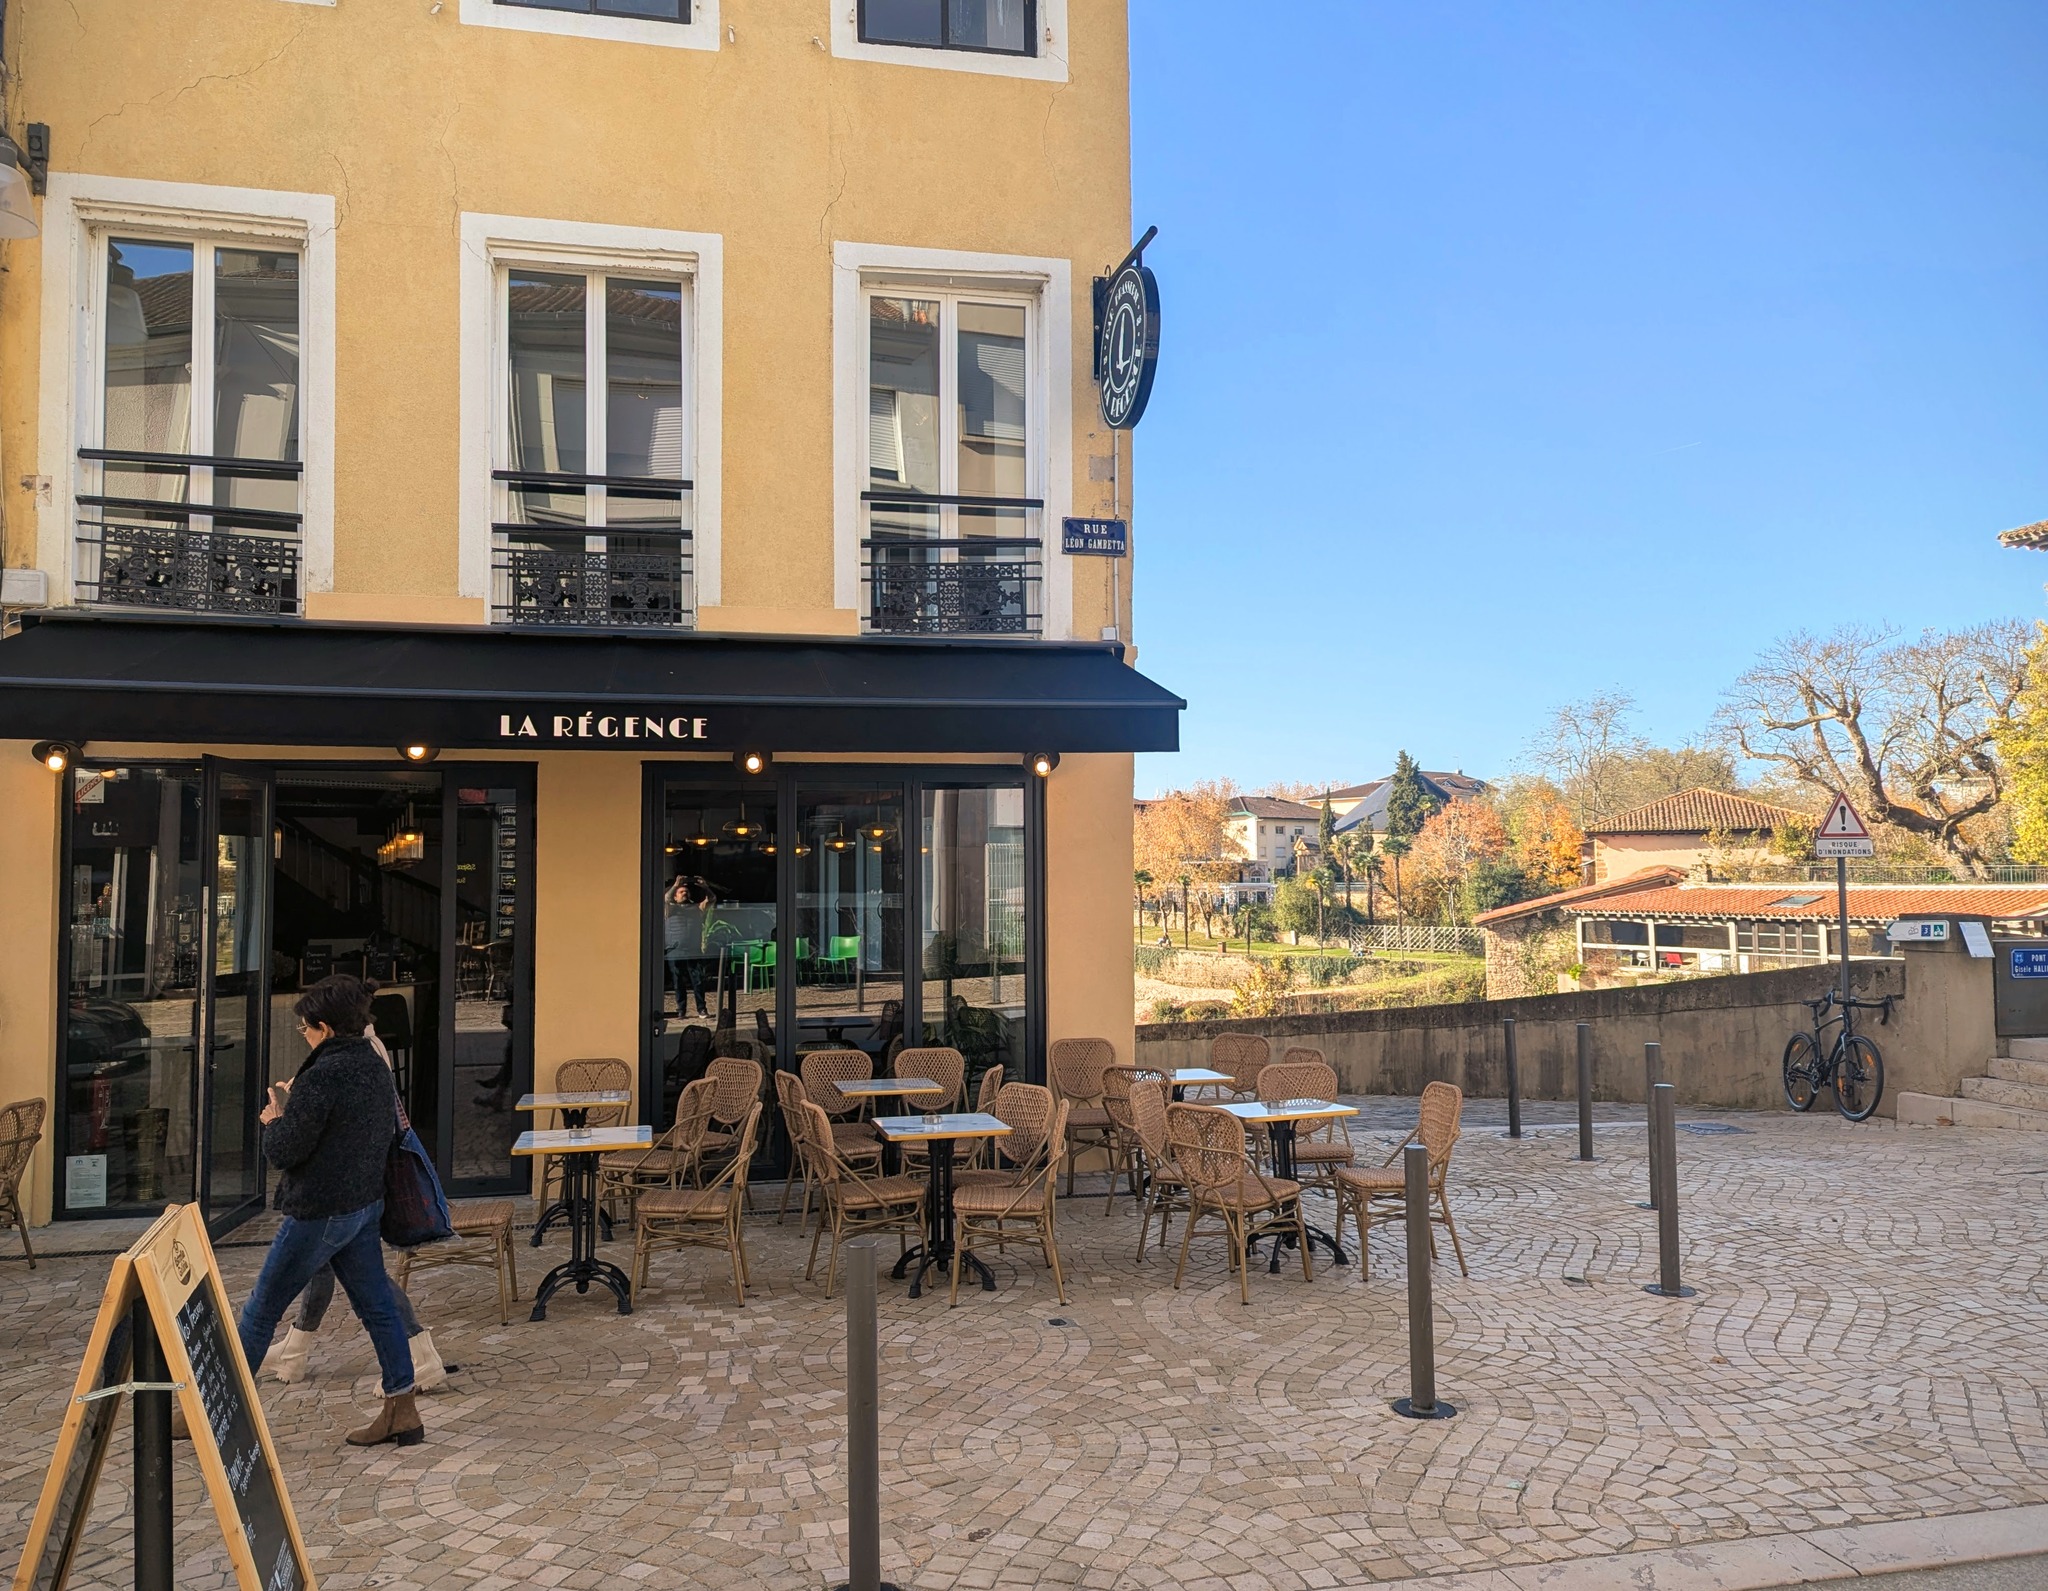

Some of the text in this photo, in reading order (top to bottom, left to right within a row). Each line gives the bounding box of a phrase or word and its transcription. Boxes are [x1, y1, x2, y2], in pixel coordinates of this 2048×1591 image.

[1083, 523, 1108, 534] RUE
[1065, 536, 1125, 551] LÉON GAMBETTA
[500, 711, 708, 739] LA RÉGENCE
[2031, 954, 2047, 962] PONT
